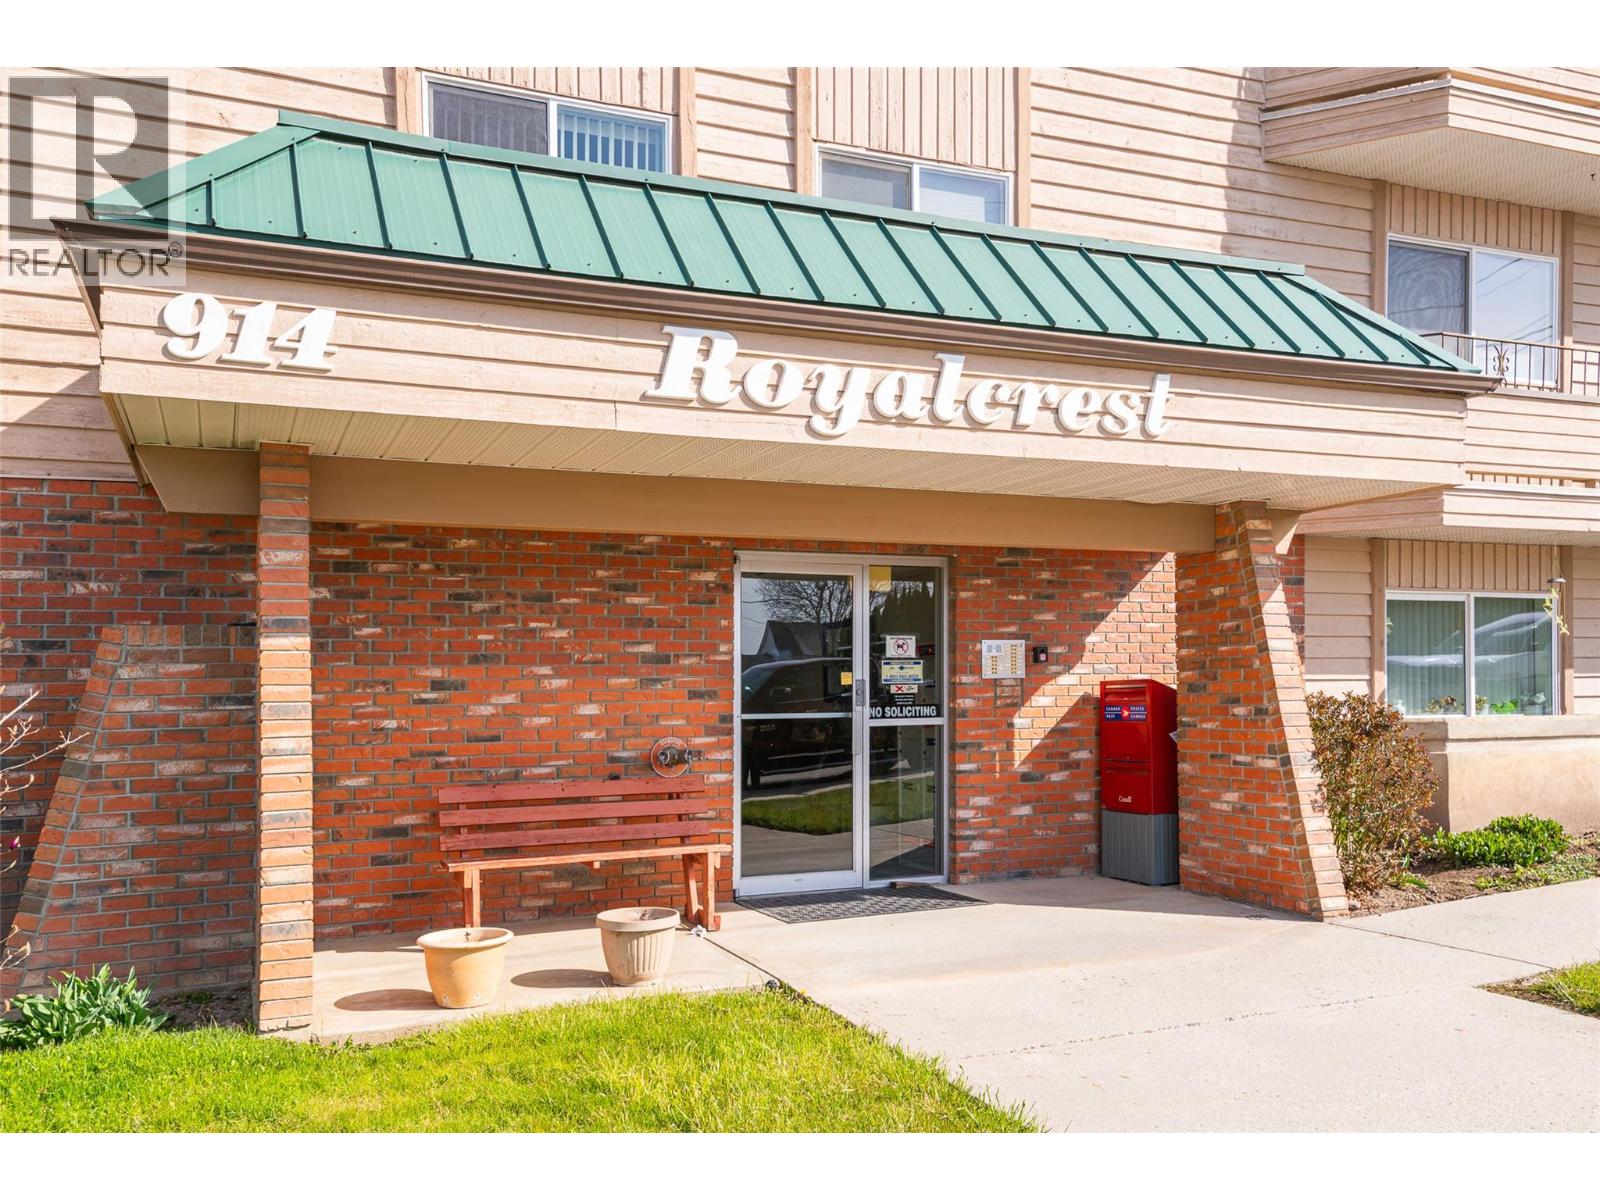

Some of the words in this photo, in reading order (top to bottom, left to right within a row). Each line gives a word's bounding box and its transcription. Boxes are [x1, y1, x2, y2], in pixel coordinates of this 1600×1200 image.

[161, 292, 339, 371] 914
[643, 325, 1175, 438] Royalcrest
[869, 706, 882, 717] NO
[885, 706, 937, 717] SOLICITING
